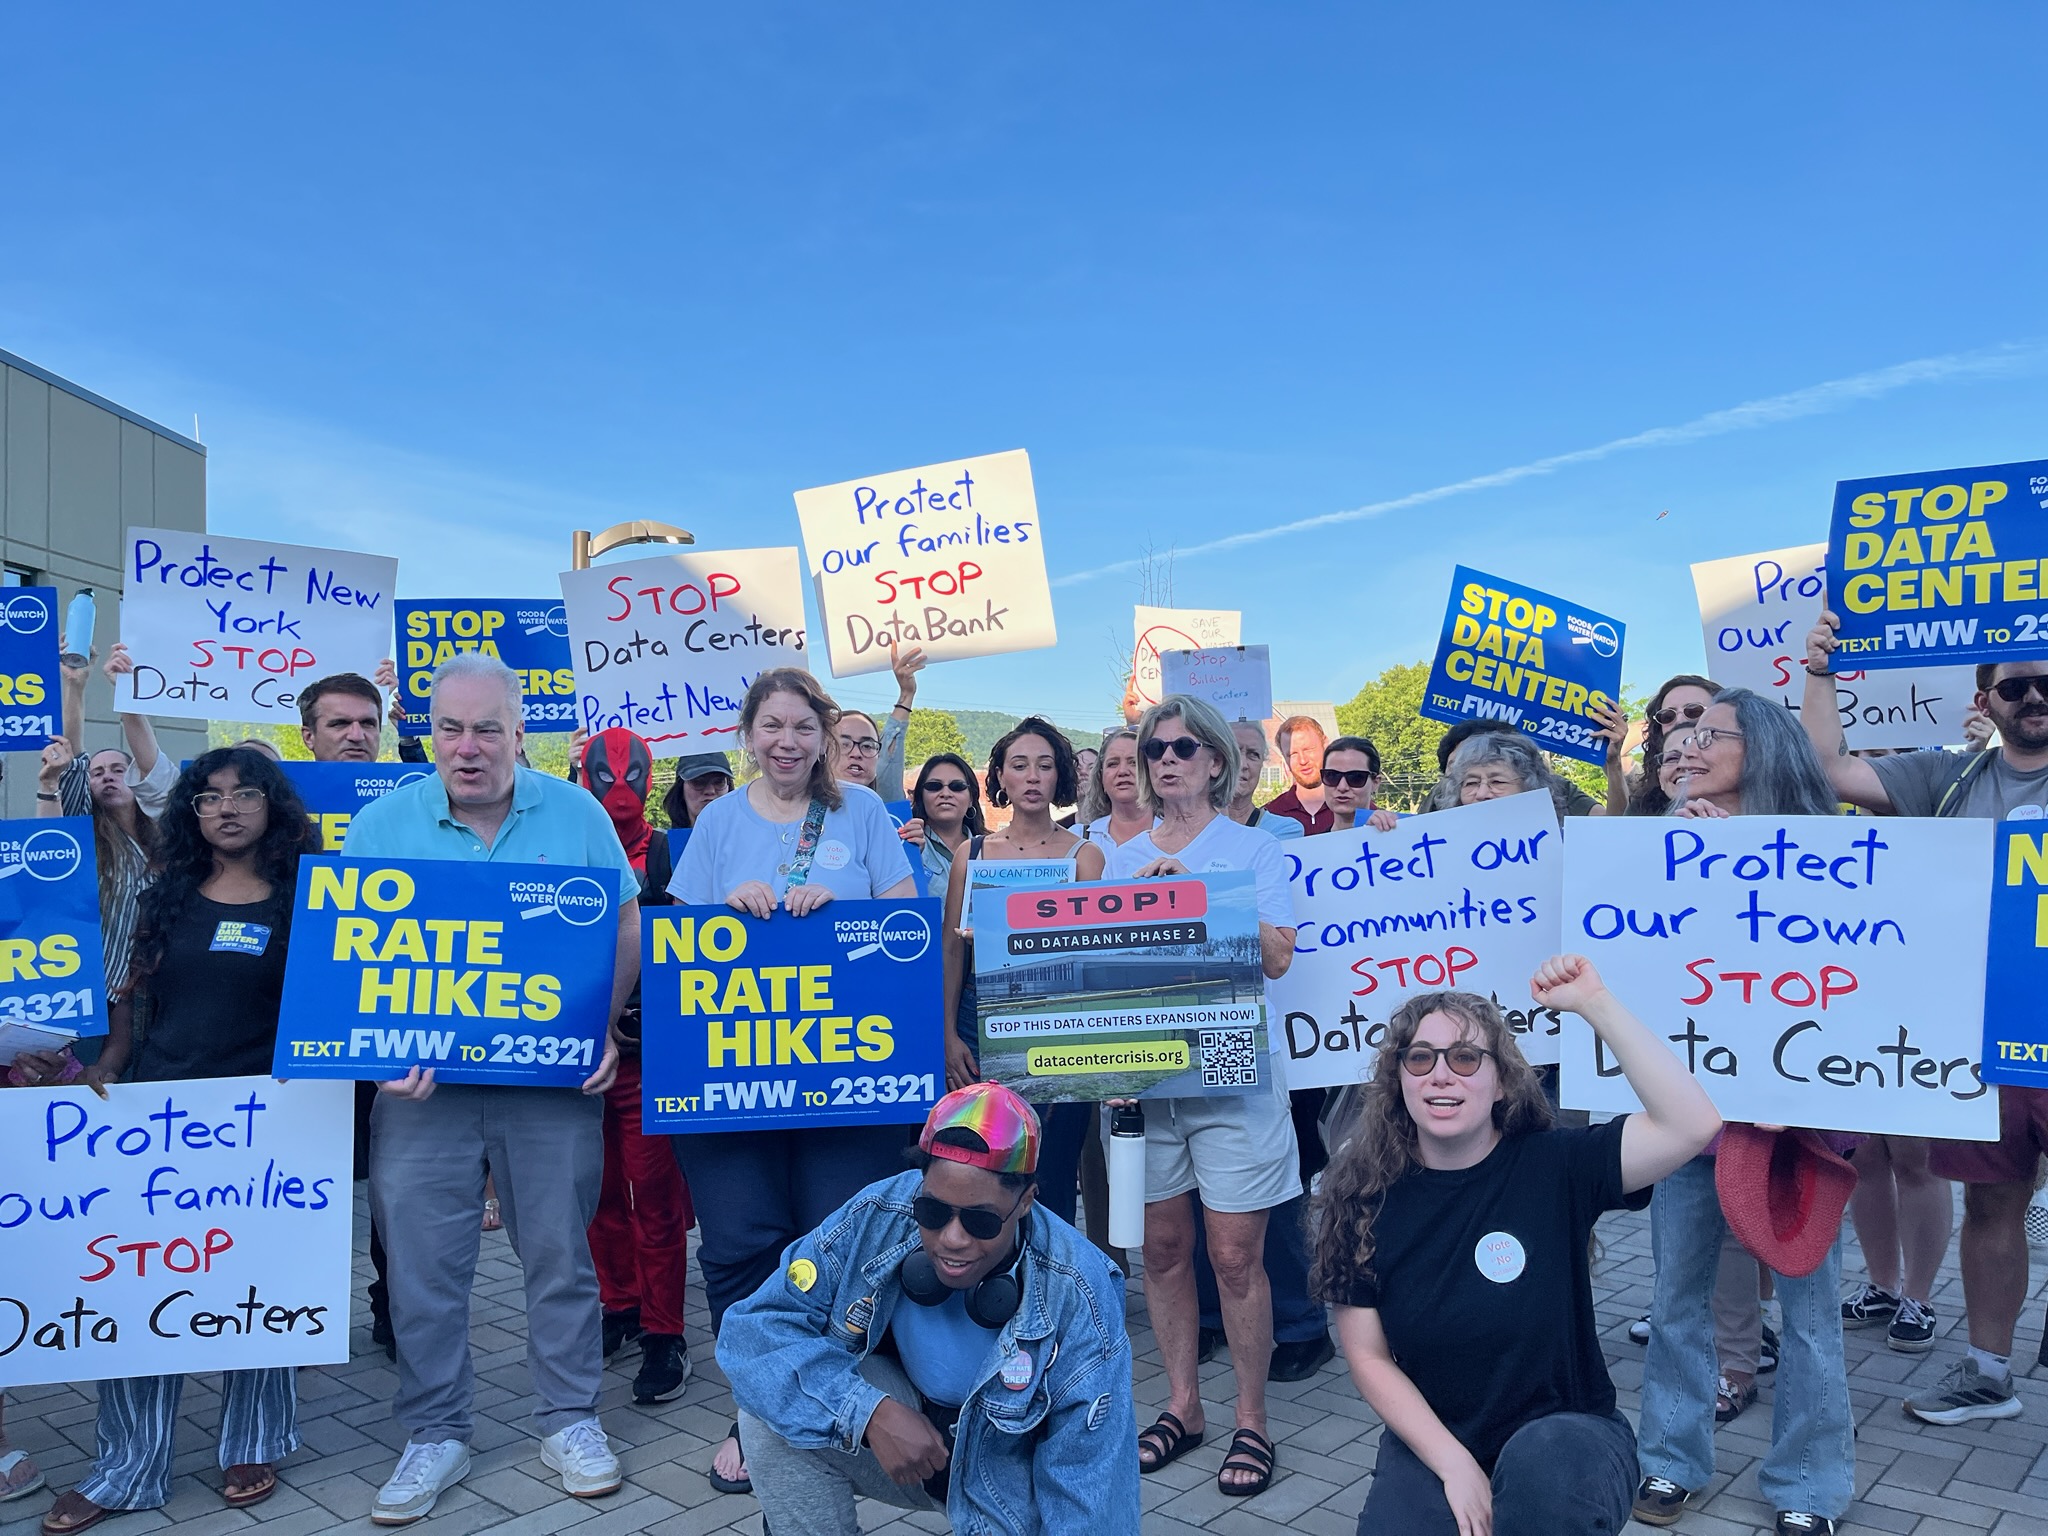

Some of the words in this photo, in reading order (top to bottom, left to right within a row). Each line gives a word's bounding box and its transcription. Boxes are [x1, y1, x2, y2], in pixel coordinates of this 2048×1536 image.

[854, 469, 974, 525] Protect
[1849, 480, 2008, 528] STOP
[822, 541, 880, 574] our
[896, 512, 1033, 557] families
[1844, 521, 1996, 571] DATA
[135, 539, 288, 594] Protect
[306, 568, 381, 609] New
[875, 561, 983, 604] STOP
[1754, 553, 1828, 604] Pro
[8, 610, 44, 619] WATCH
[607, 573, 741, 622] STOP
[1460, 583, 1557, 635] STOP
[206, 599, 301, 640] York
[406, 610, 505, 638] STOP
[1191, 616, 1221, 629] SAVE
[1201, 628, 1225, 639] OUR
[1568, 623, 1591, 637] WATER
[1593, 632, 1616, 648] WATCH
[1718, 619, 1792, 652] our
[1840, 637, 1881, 653] TEXT
[1885, 618, 1978, 650] FWW
[1984, 629, 2011, 644] TO
[189, 640, 317, 677] STOP
[585, 630, 668, 672] Data
[684, 614, 806, 652] Centers
[1193, 650, 1227, 668] Stop
[1451, 614, 1545, 670] DATA
[132, 666, 228, 702] Data
[251, 678, 300, 709] Ce
[1189, 671, 1230, 687] Building
[1445, 650, 1612, 721] CENTERS
[0, 714, 53, 737] 321
[583, 682, 678, 738] Protect
[684, 682, 744, 719] New
[1432, 693, 1461, 711] TEXT
[1461, 694, 1523, 726] FWW
[1522, 719, 1538, 733] TO
[1538, 717, 1605, 751] 23321
[26, 848, 77, 862] WATCH
[1471, 829, 1549, 870] our
[1665, 827, 1889, 889] Protect
[308, 866, 416, 912] NO
[973, 868, 997, 878] YOU
[999, 868, 1032, 878] CAN'T
[1034, 867, 1068, 878] DRINK
[511, 893, 553, 904] WATER
[559, 895, 603, 907] WATCH
[1036, 890, 1176, 918] STOP!
[1583, 903, 1698, 940] our
[1737, 890, 1906, 946] town
[215, 935, 259, 945] CENTERS
[333, 917, 504, 965] RATE
[653, 915, 747, 964] NO
[836, 931, 877, 943] WATER
[882, 930, 926, 941] WATCH
[1013, 938, 1034, 950] NO
[1041, 933, 1124, 949] DATABANK
[1130, 929, 1181, 943] PHASE
[1187, 928, 1196, 940] 2
[680, 965, 833, 1016] RATE
[1351, 946, 1478, 996] STOP
[1680, 958, 1859, 1011] STOP
[358, 968, 562, 1022] HIKES
[707, 1015, 895, 1068] HIKES
[990, 1021, 1021, 1033] STOP
[1024, 1019, 1051, 1031] THIS
[1053, 1018, 1086, 1030] DATA
[1087, 1014, 1143, 1028] CENTERS
[1145, 1010, 1217, 1026] EXPANSION
[1219, 1009, 1255, 1021] NOW!
[290, 1040, 345, 1058] TEXT
[348, 1028, 456, 1060] FWW
[460, 1046, 486, 1062] TO
[488, 1034, 595, 1066] 23321
[1034, 1049, 1184, 1070] datacentercrisis.org
[1773, 1019, 1988, 1100] Centers
[1997, 1041, 2048, 1062] TEXT
[655, 1096, 700, 1113] TEXT
[704, 1079, 797, 1111] FWW
[802, 1091, 828, 1107] TO
[831, 1073, 935, 1105] 23321
[47, 1091, 266, 1161] Protect
[0, 1188, 110, 1228] our
[141, 1158, 334, 1215] families
[79, 1228, 234, 1282] STOP
[1486, 1240, 1511, 1252] Vote
[149, 1285, 328, 1338] Centers
[1003, 1375, 1031, 1384] GREAT
